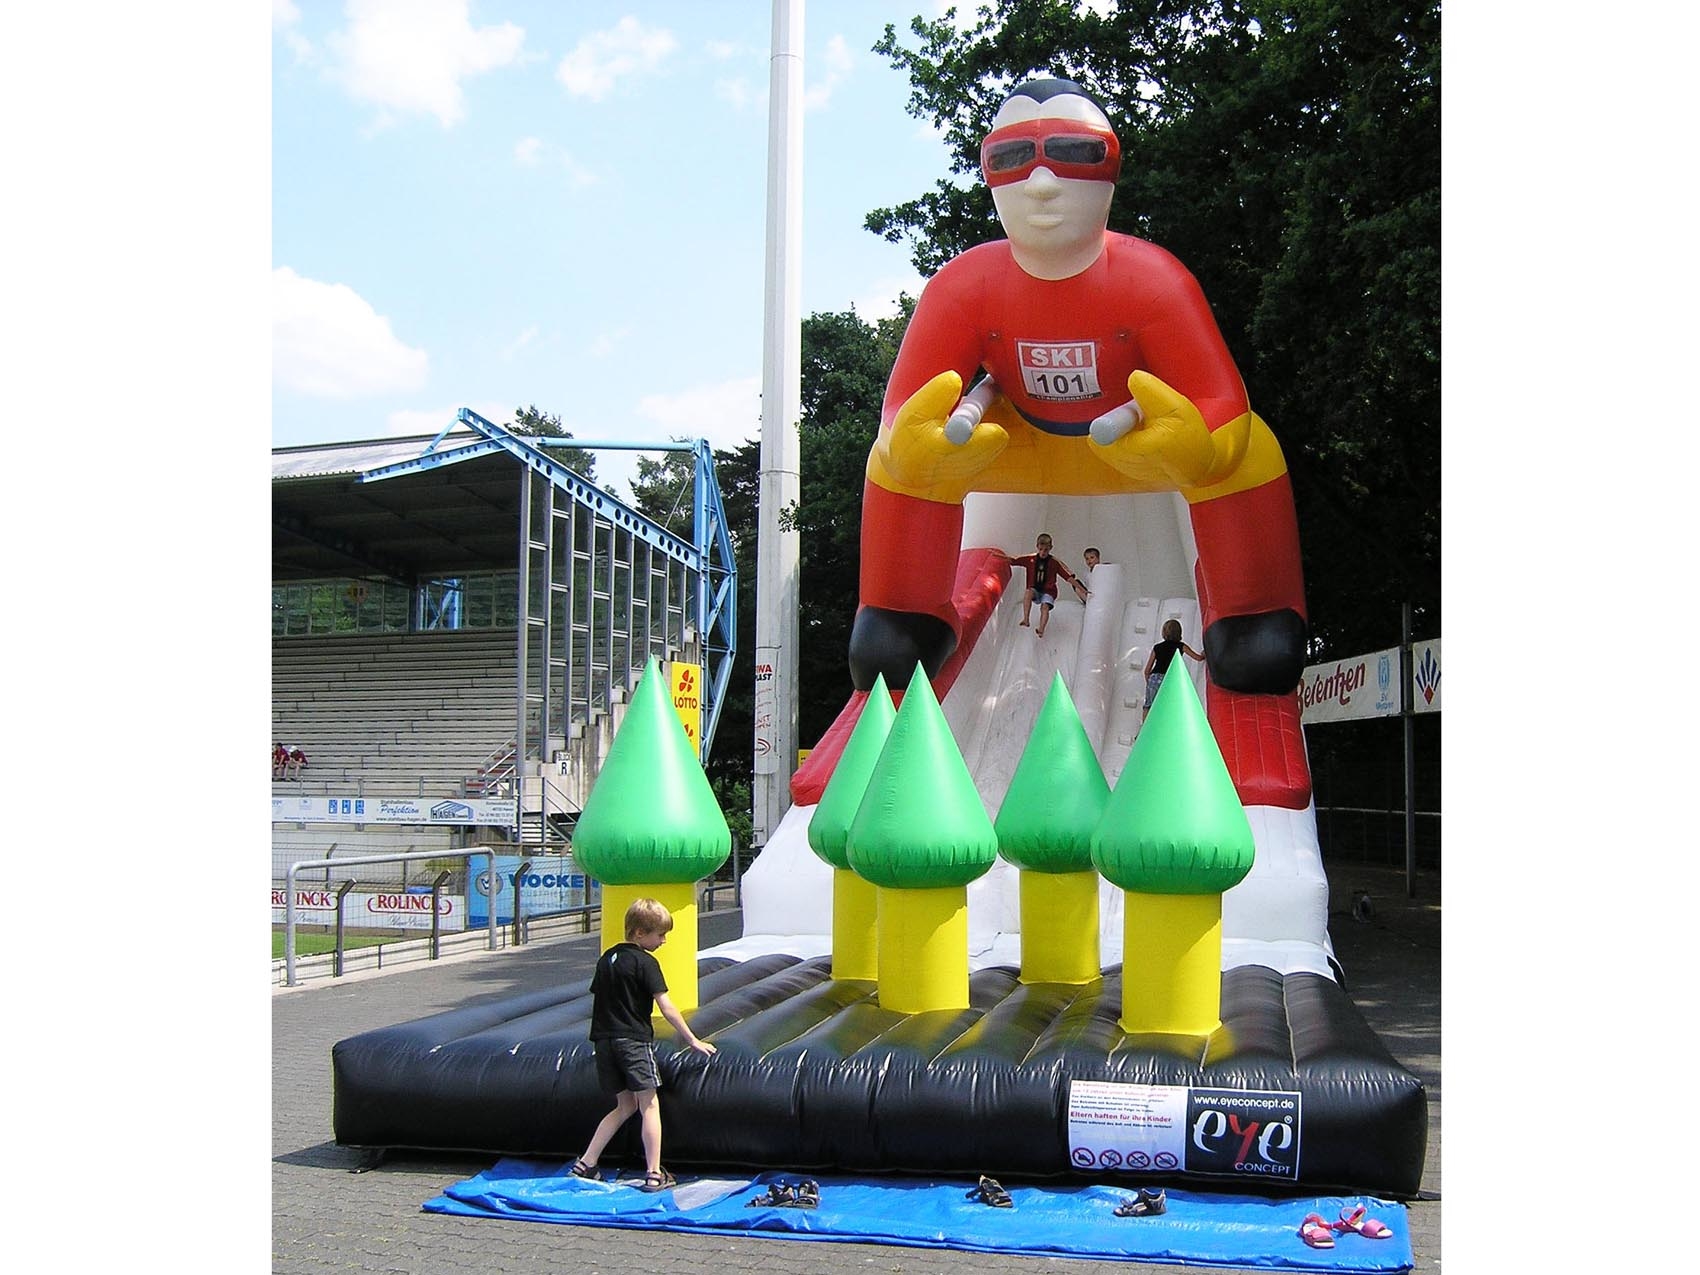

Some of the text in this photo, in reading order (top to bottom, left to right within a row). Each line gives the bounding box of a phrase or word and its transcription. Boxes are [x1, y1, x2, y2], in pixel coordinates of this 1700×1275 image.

[1031, 348, 1083, 367] SKI
[1037, 374, 1084, 393] 101
[674, 697, 697, 709] LOTTO
[561, 762, 567, 774] R
[272, 891, 331, 906] ROINCK
[1194, 1096, 1294, 1109] www.eyeconcept.de
[1193, 1110, 1292, 1165] eye
[1235, 1162, 1290, 1174] CONCEPT
